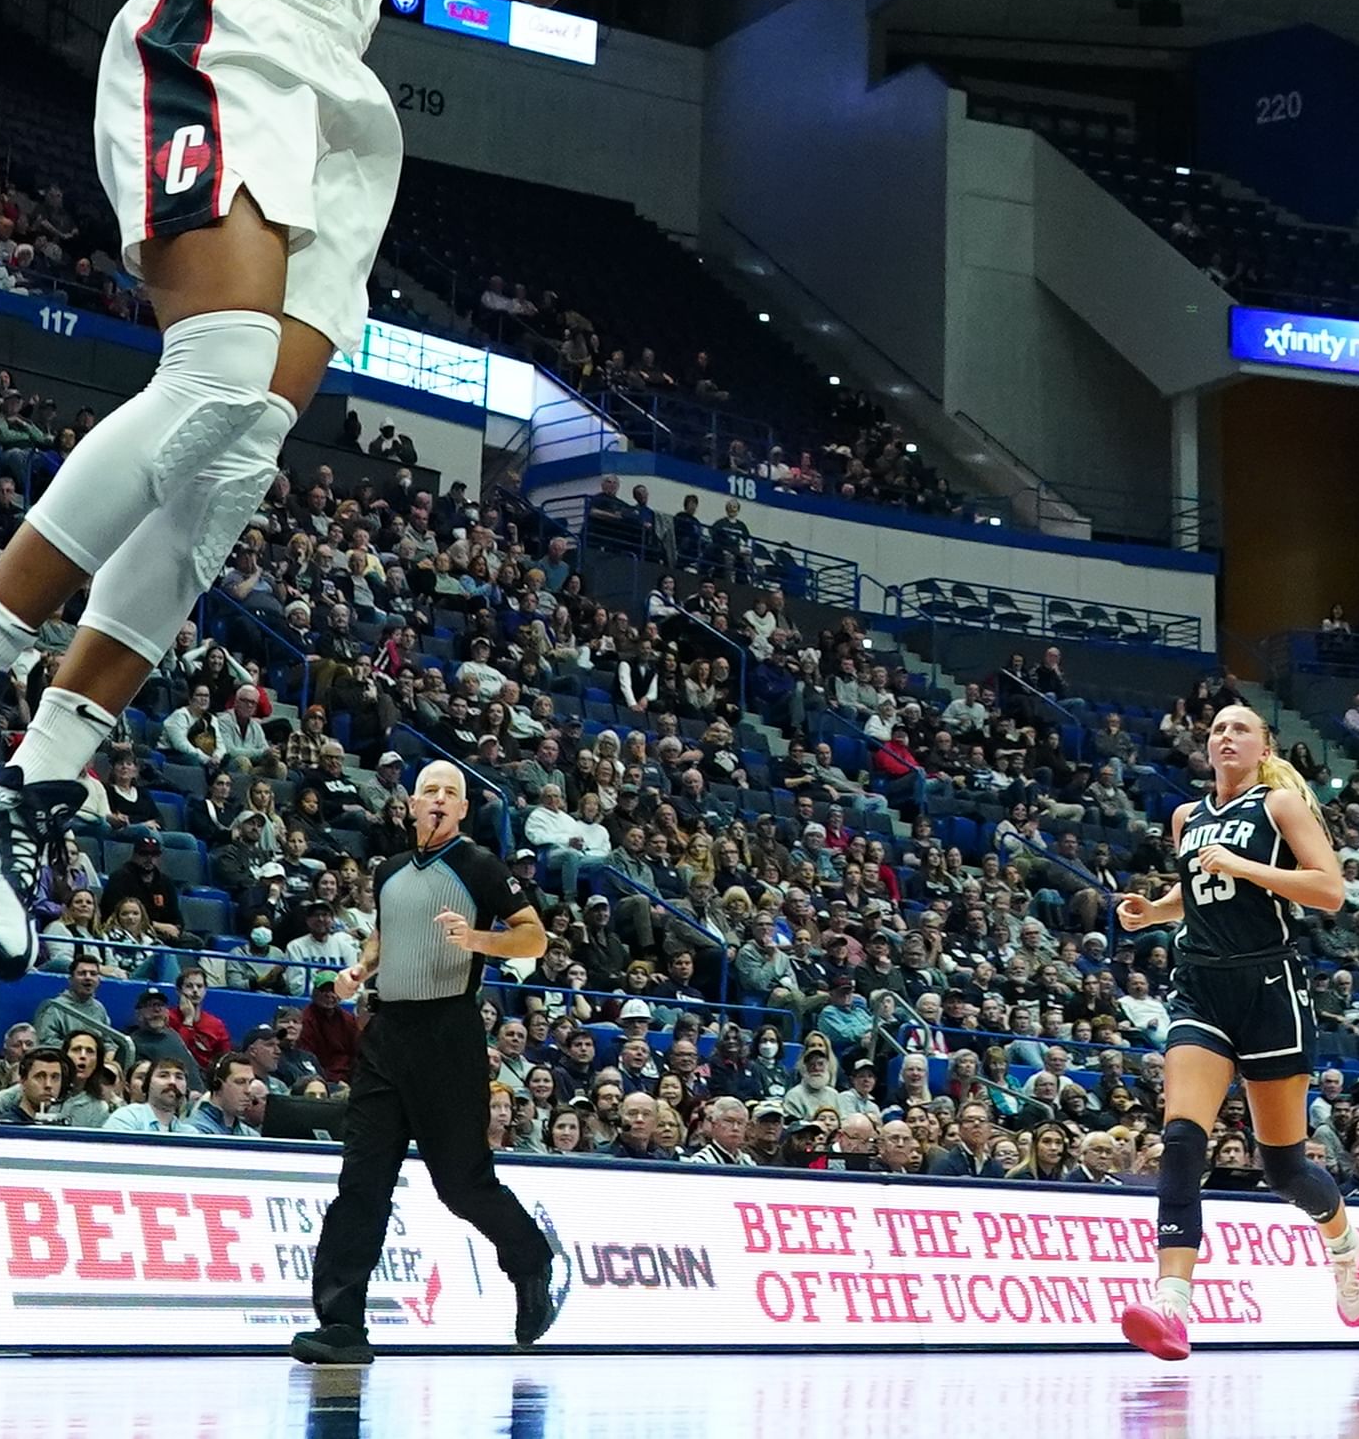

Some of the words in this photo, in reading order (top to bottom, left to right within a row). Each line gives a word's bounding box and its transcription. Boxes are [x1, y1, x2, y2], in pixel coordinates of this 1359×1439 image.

[397, 83, 444, 116] 219
[1257, 91, 1302, 124] 220
[39, 306, 78, 337] 117
[1264, 322, 1346, 362] xfinity
[727, 475, 757, 500] 118
[1179, 820, 1255, 858] BUTLER
[266, 1197, 313, 1234] IT'S
[735, 1202, 875, 1269] BEEF,
[872, 1208, 970, 1259] THE
[973, 1212, 1212, 1263] PREFERRD
[575, 1241, 718, 1290] UCONN
[757, 1271, 821, 1322] OF
[829, 1272, 932, 1322] THE
[934, 1274, 1099, 1324] UCONN
[1100, 1277, 1262, 1324] HKIES
